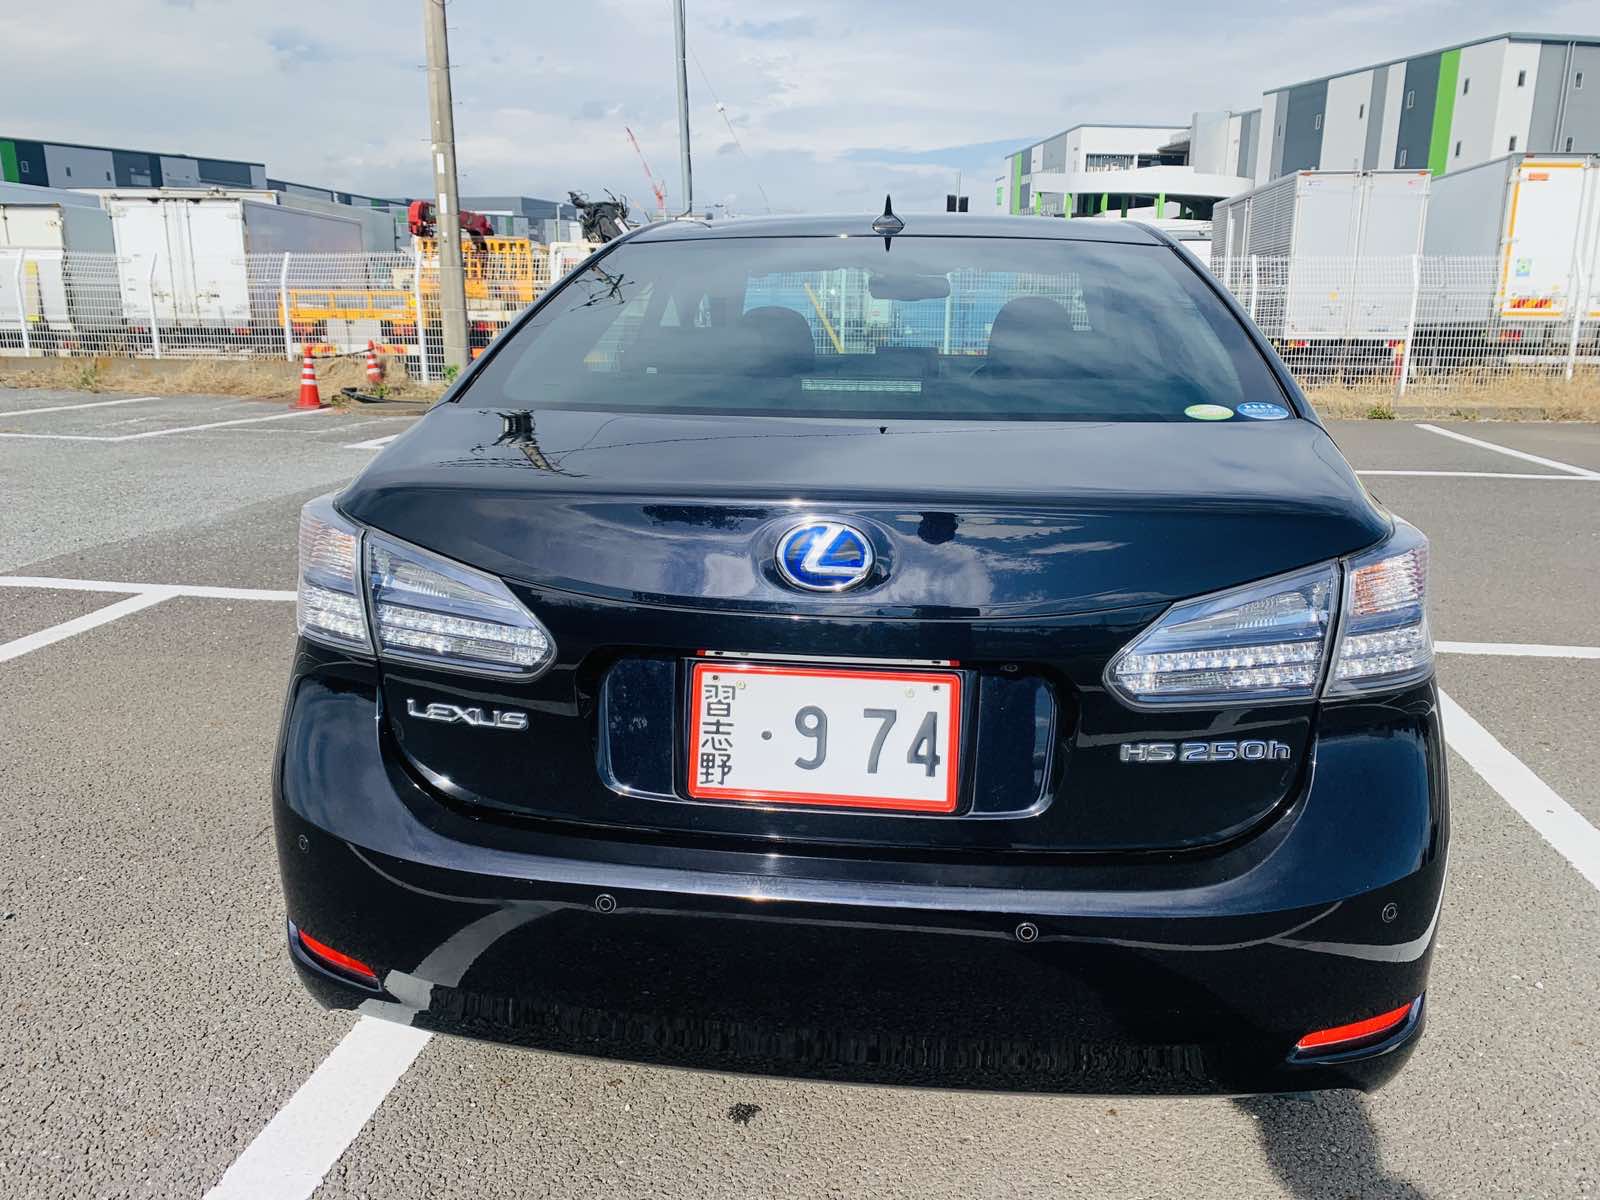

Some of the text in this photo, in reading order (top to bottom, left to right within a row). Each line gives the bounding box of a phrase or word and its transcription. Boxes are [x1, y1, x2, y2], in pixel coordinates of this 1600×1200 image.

[406, 698, 529, 730] LEXUS
[699, 684, 736, 785] 習志野
[1119, 740, 1291, 761] HS 250h
